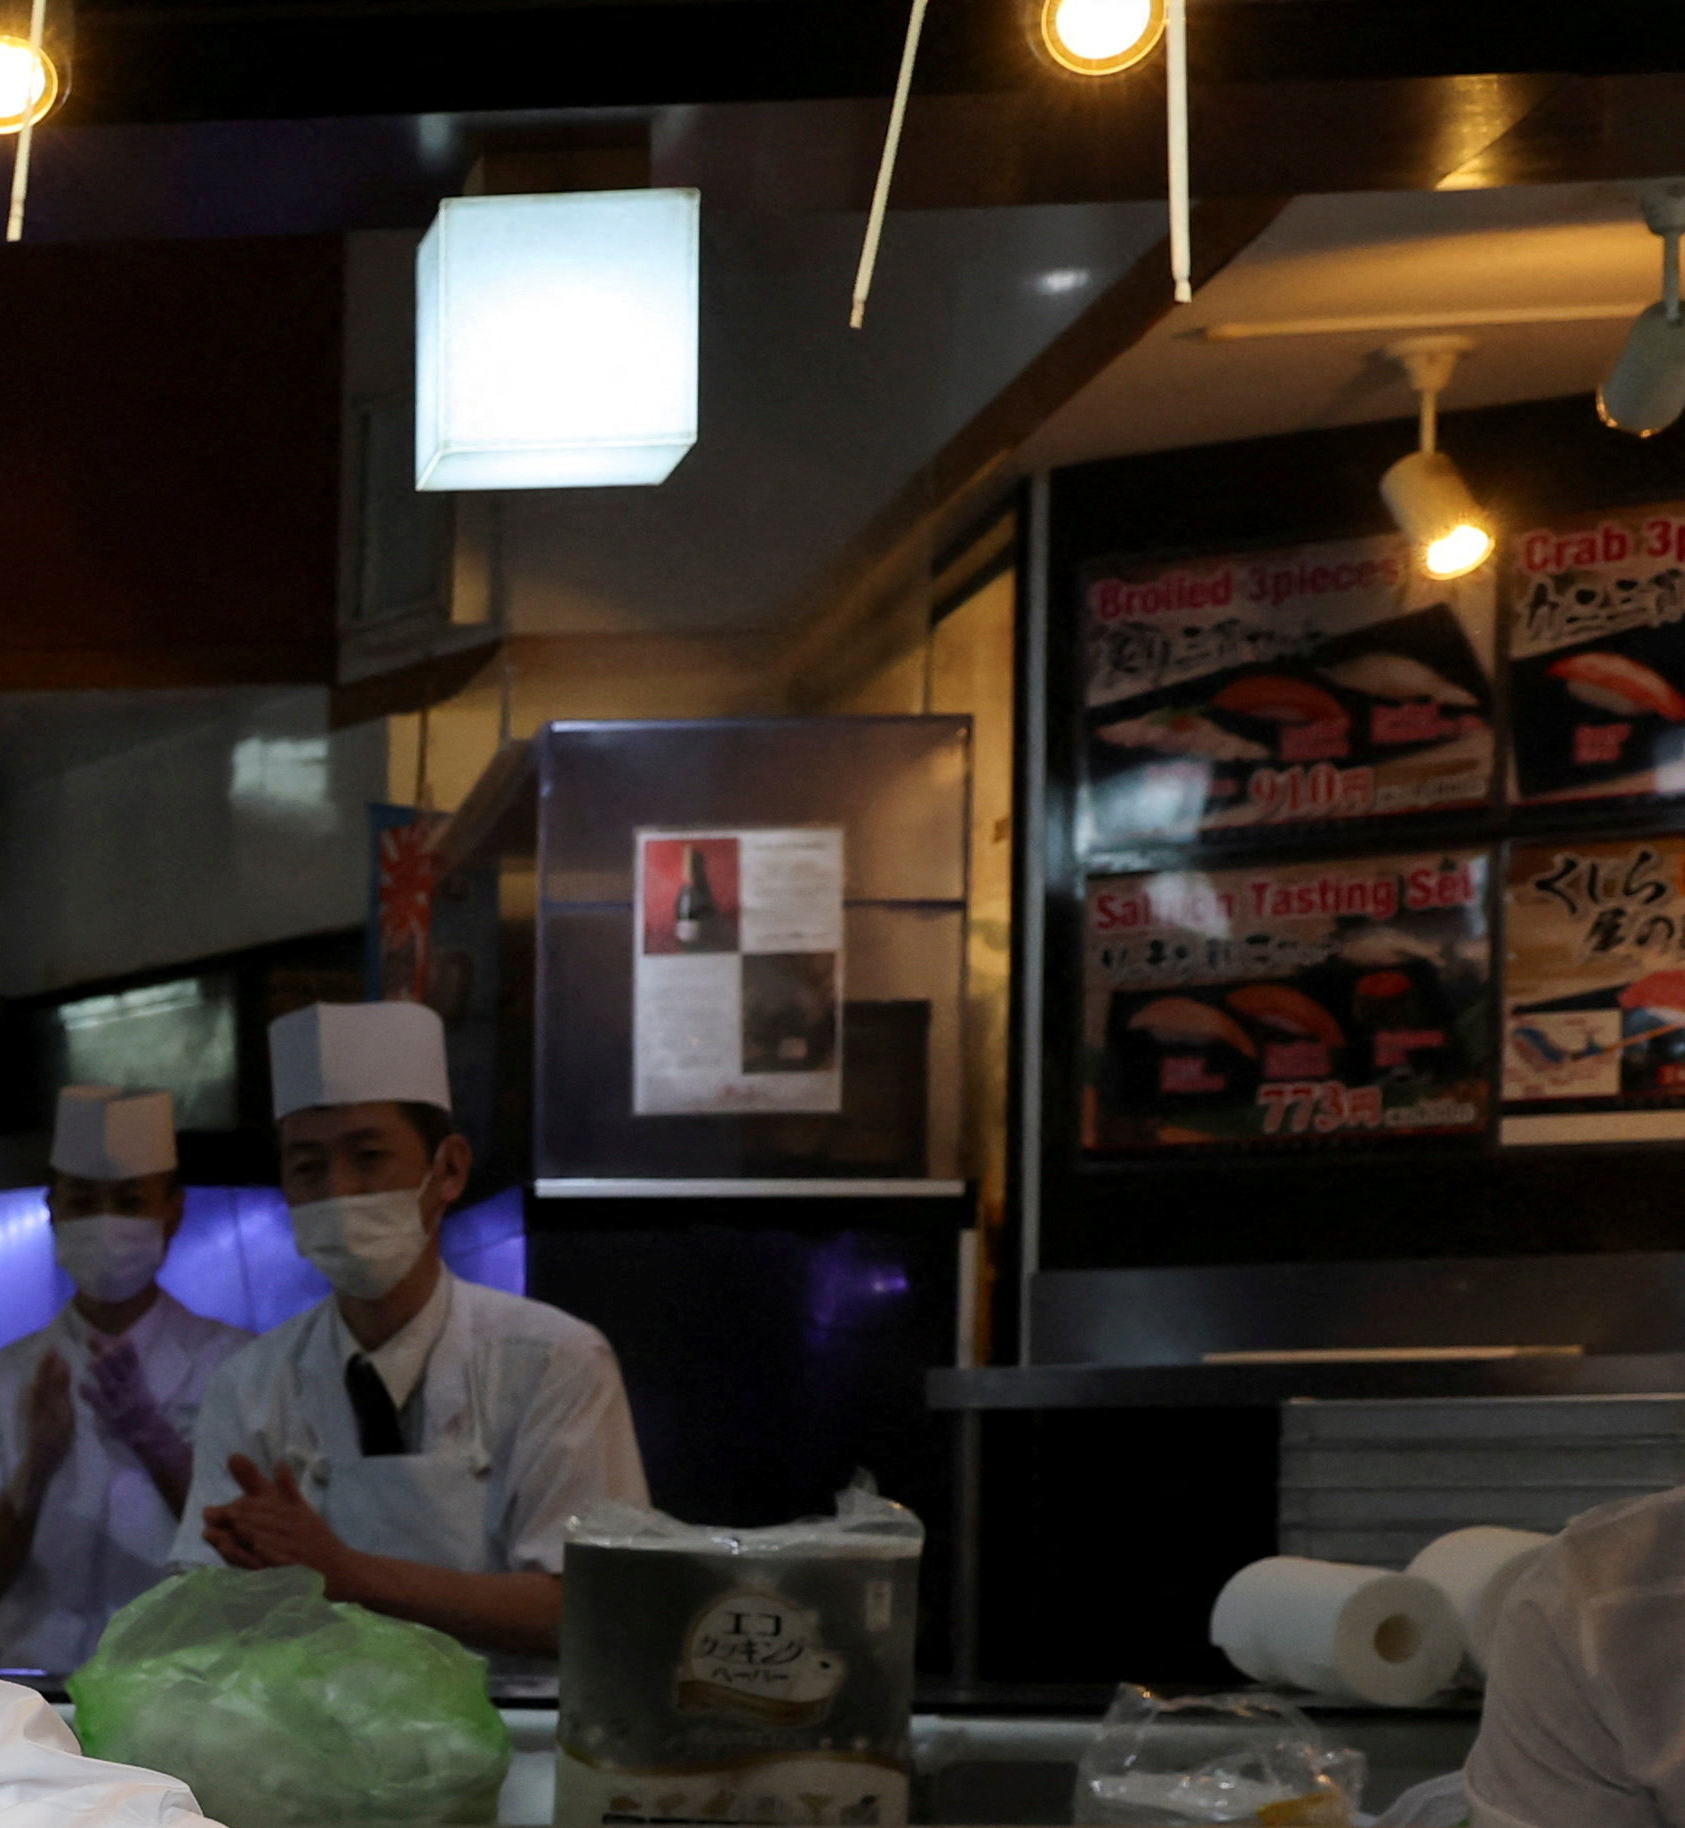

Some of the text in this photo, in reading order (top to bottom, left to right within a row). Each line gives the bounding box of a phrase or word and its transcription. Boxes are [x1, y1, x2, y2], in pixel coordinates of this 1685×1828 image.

[1524, 523, 1628, 571] Crab
[1247, 555, 1399, 604] 3pieces
[1096, 886, 1235, 930] Saln
[1251, 874, 1397, 921] Tasting
[723, 1610, 783, 1638] エコ
